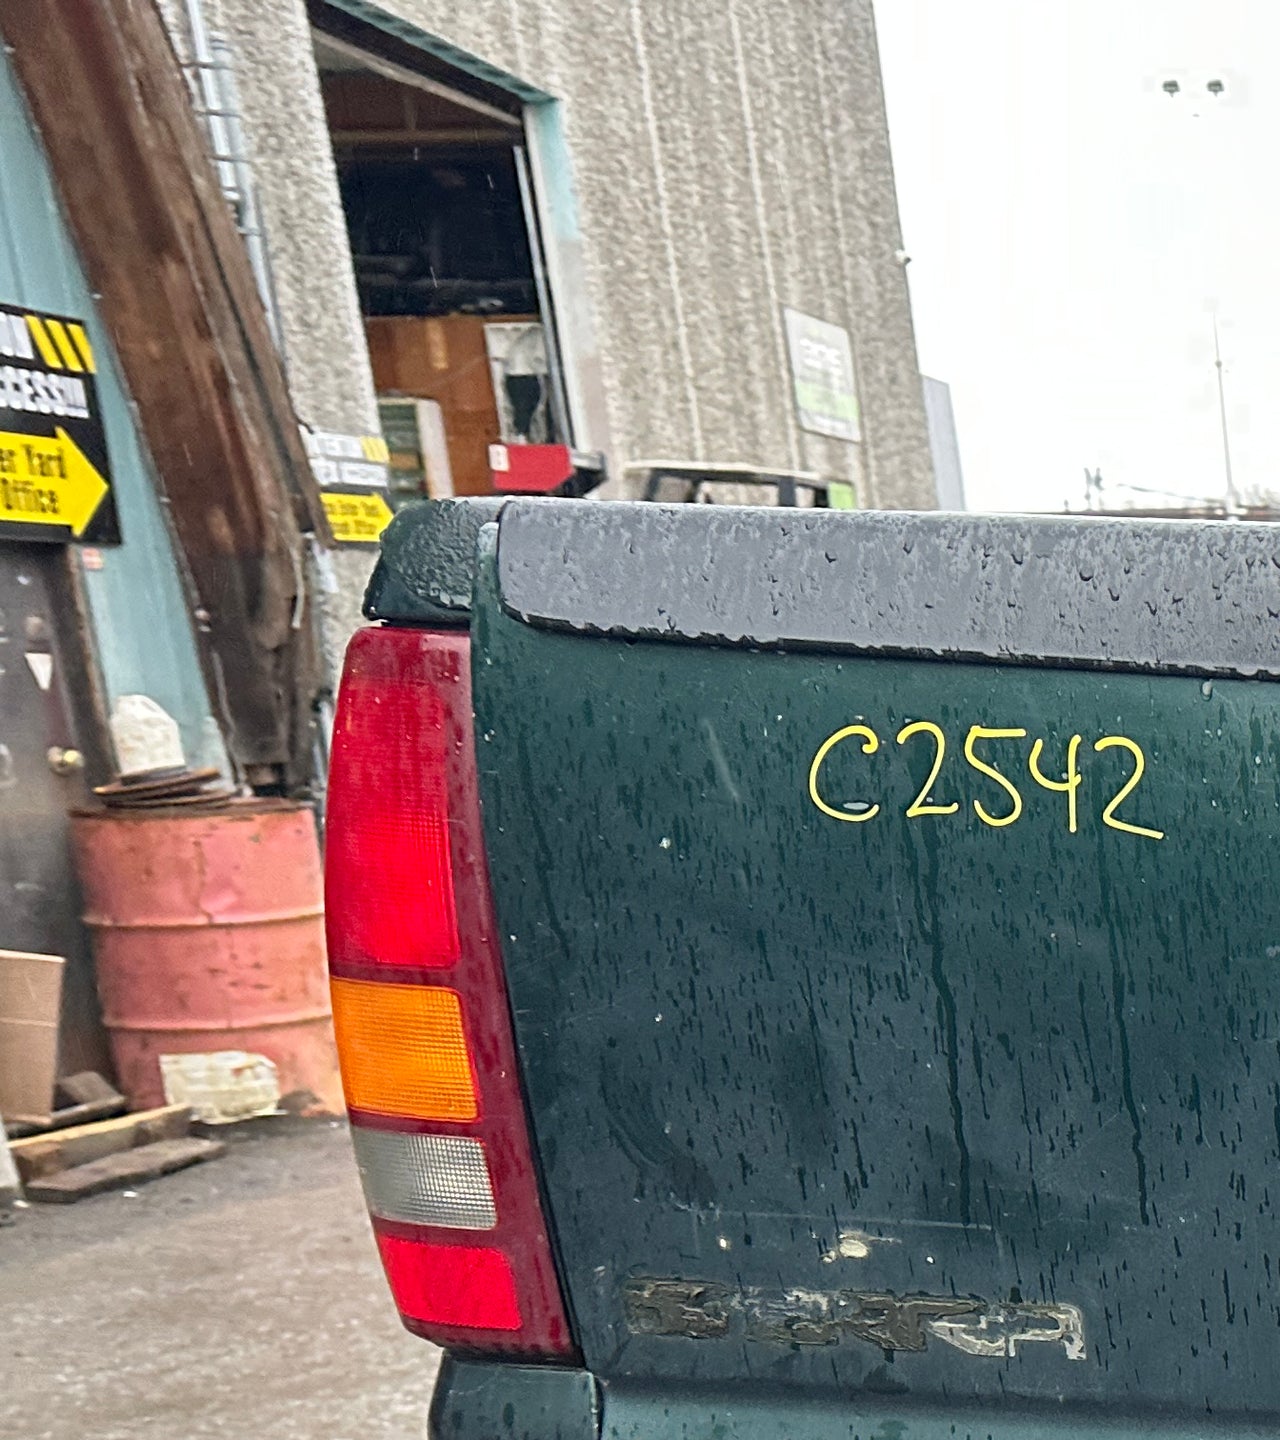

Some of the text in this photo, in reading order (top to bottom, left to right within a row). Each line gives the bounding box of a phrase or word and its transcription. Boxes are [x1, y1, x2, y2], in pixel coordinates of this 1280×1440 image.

[21, 443, 67, 479] Yard
[1, 477, 59, 514] Office
[808, 721, 1165, 840] C2542
